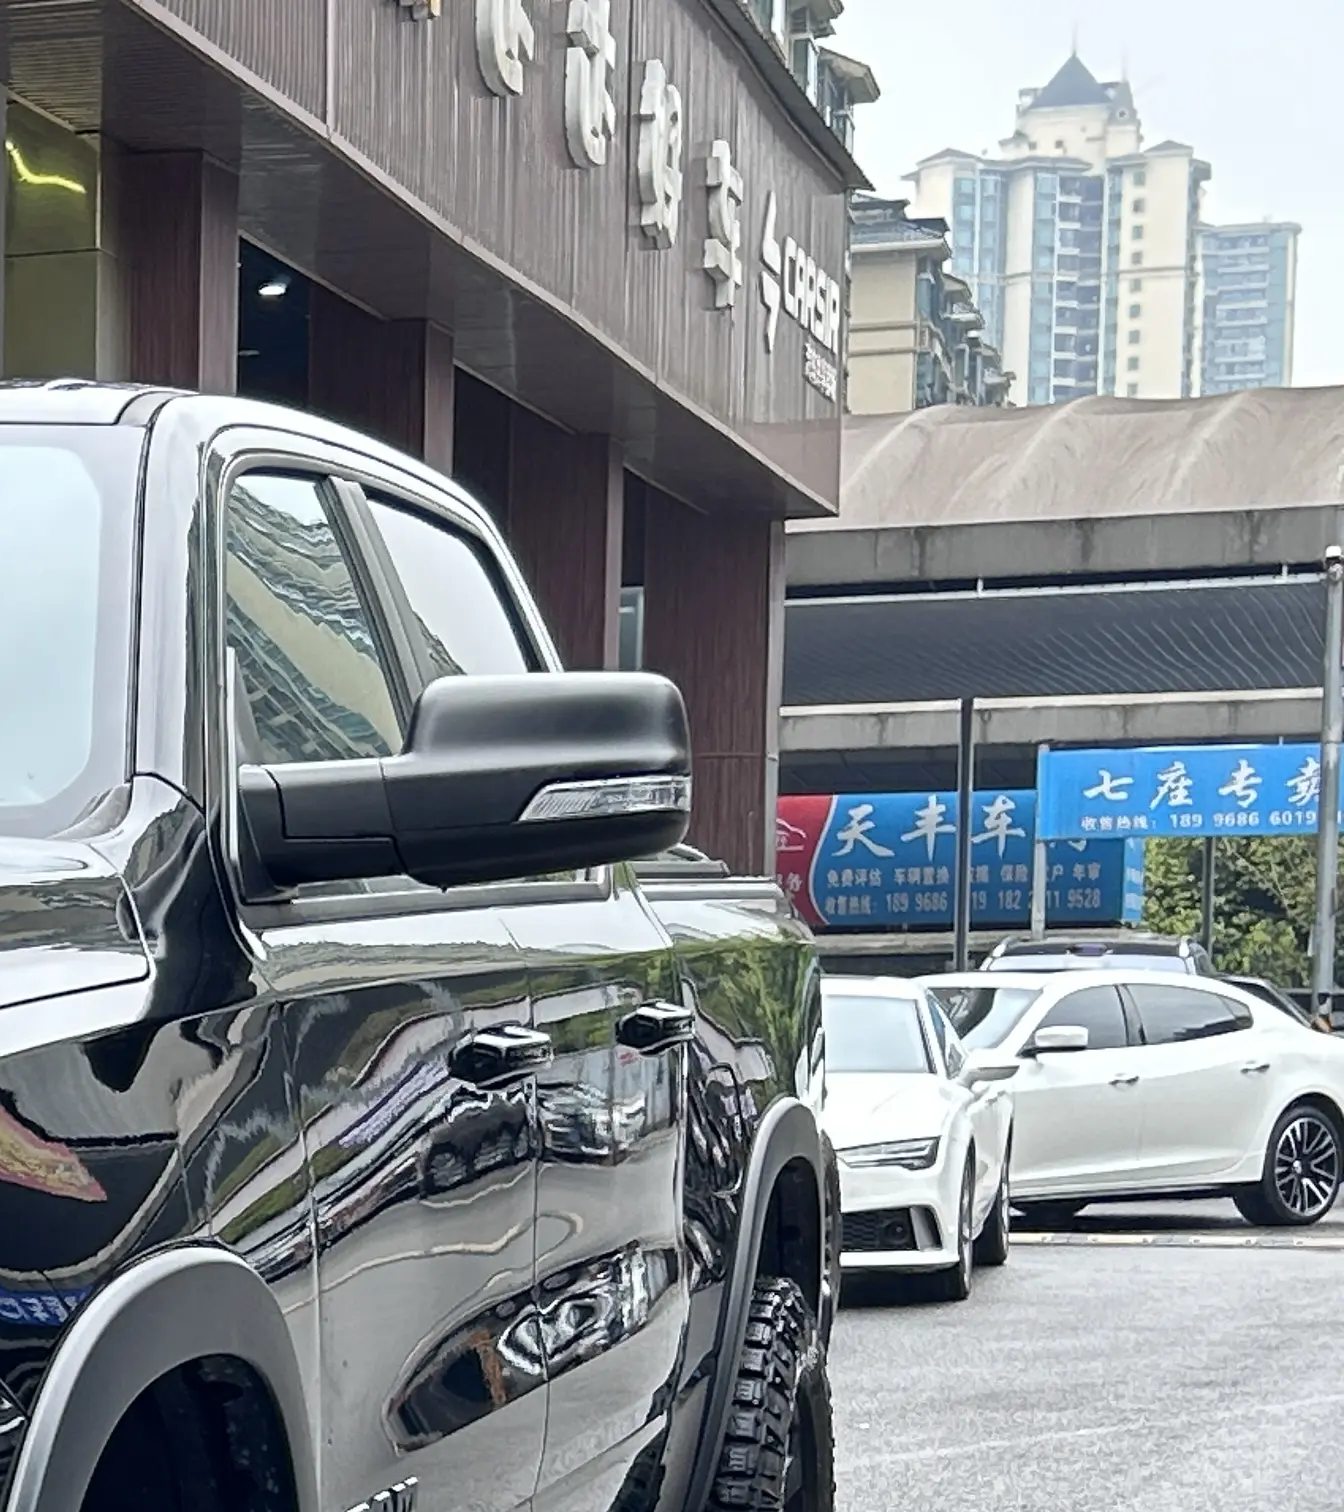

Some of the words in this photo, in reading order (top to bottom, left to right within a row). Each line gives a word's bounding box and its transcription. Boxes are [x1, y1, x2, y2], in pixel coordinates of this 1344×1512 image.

[831, 794, 1088, 862] 天丰车
[1169, 814, 1202, 829] 189
[1213, 812, 1259, 828] 9686
[1269, 810, 1317, 826] 6019
[886, 894, 908, 912] 189
